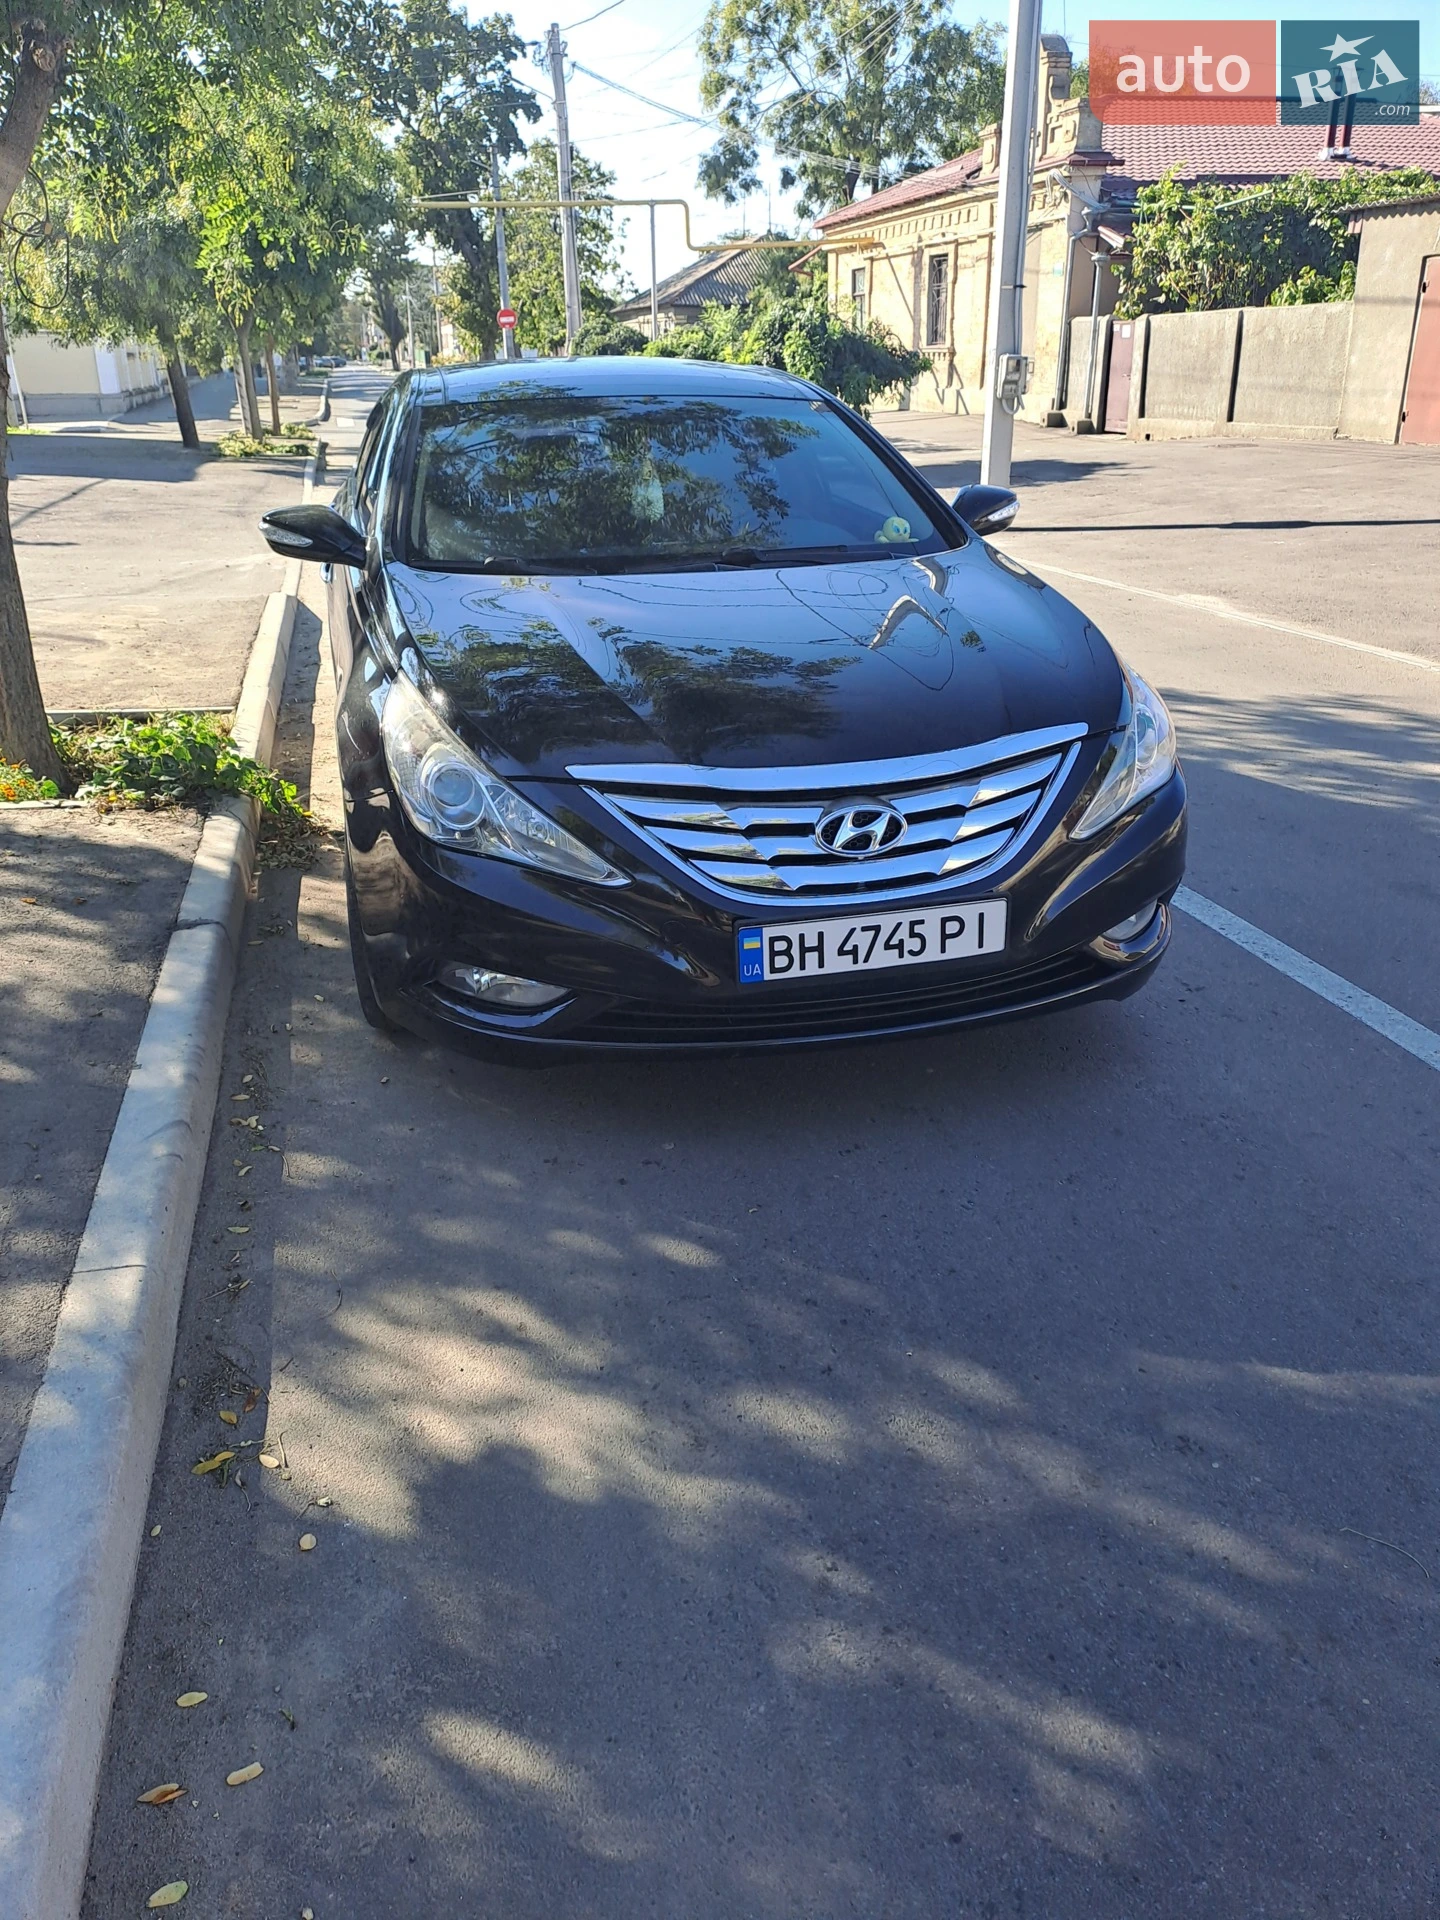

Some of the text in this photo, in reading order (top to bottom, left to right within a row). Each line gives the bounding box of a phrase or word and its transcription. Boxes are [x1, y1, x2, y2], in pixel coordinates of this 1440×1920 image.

[768, 931, 825, 974] BH
[837, 919, 927, 965] 4745
[743, 963, 762, 977] UA
